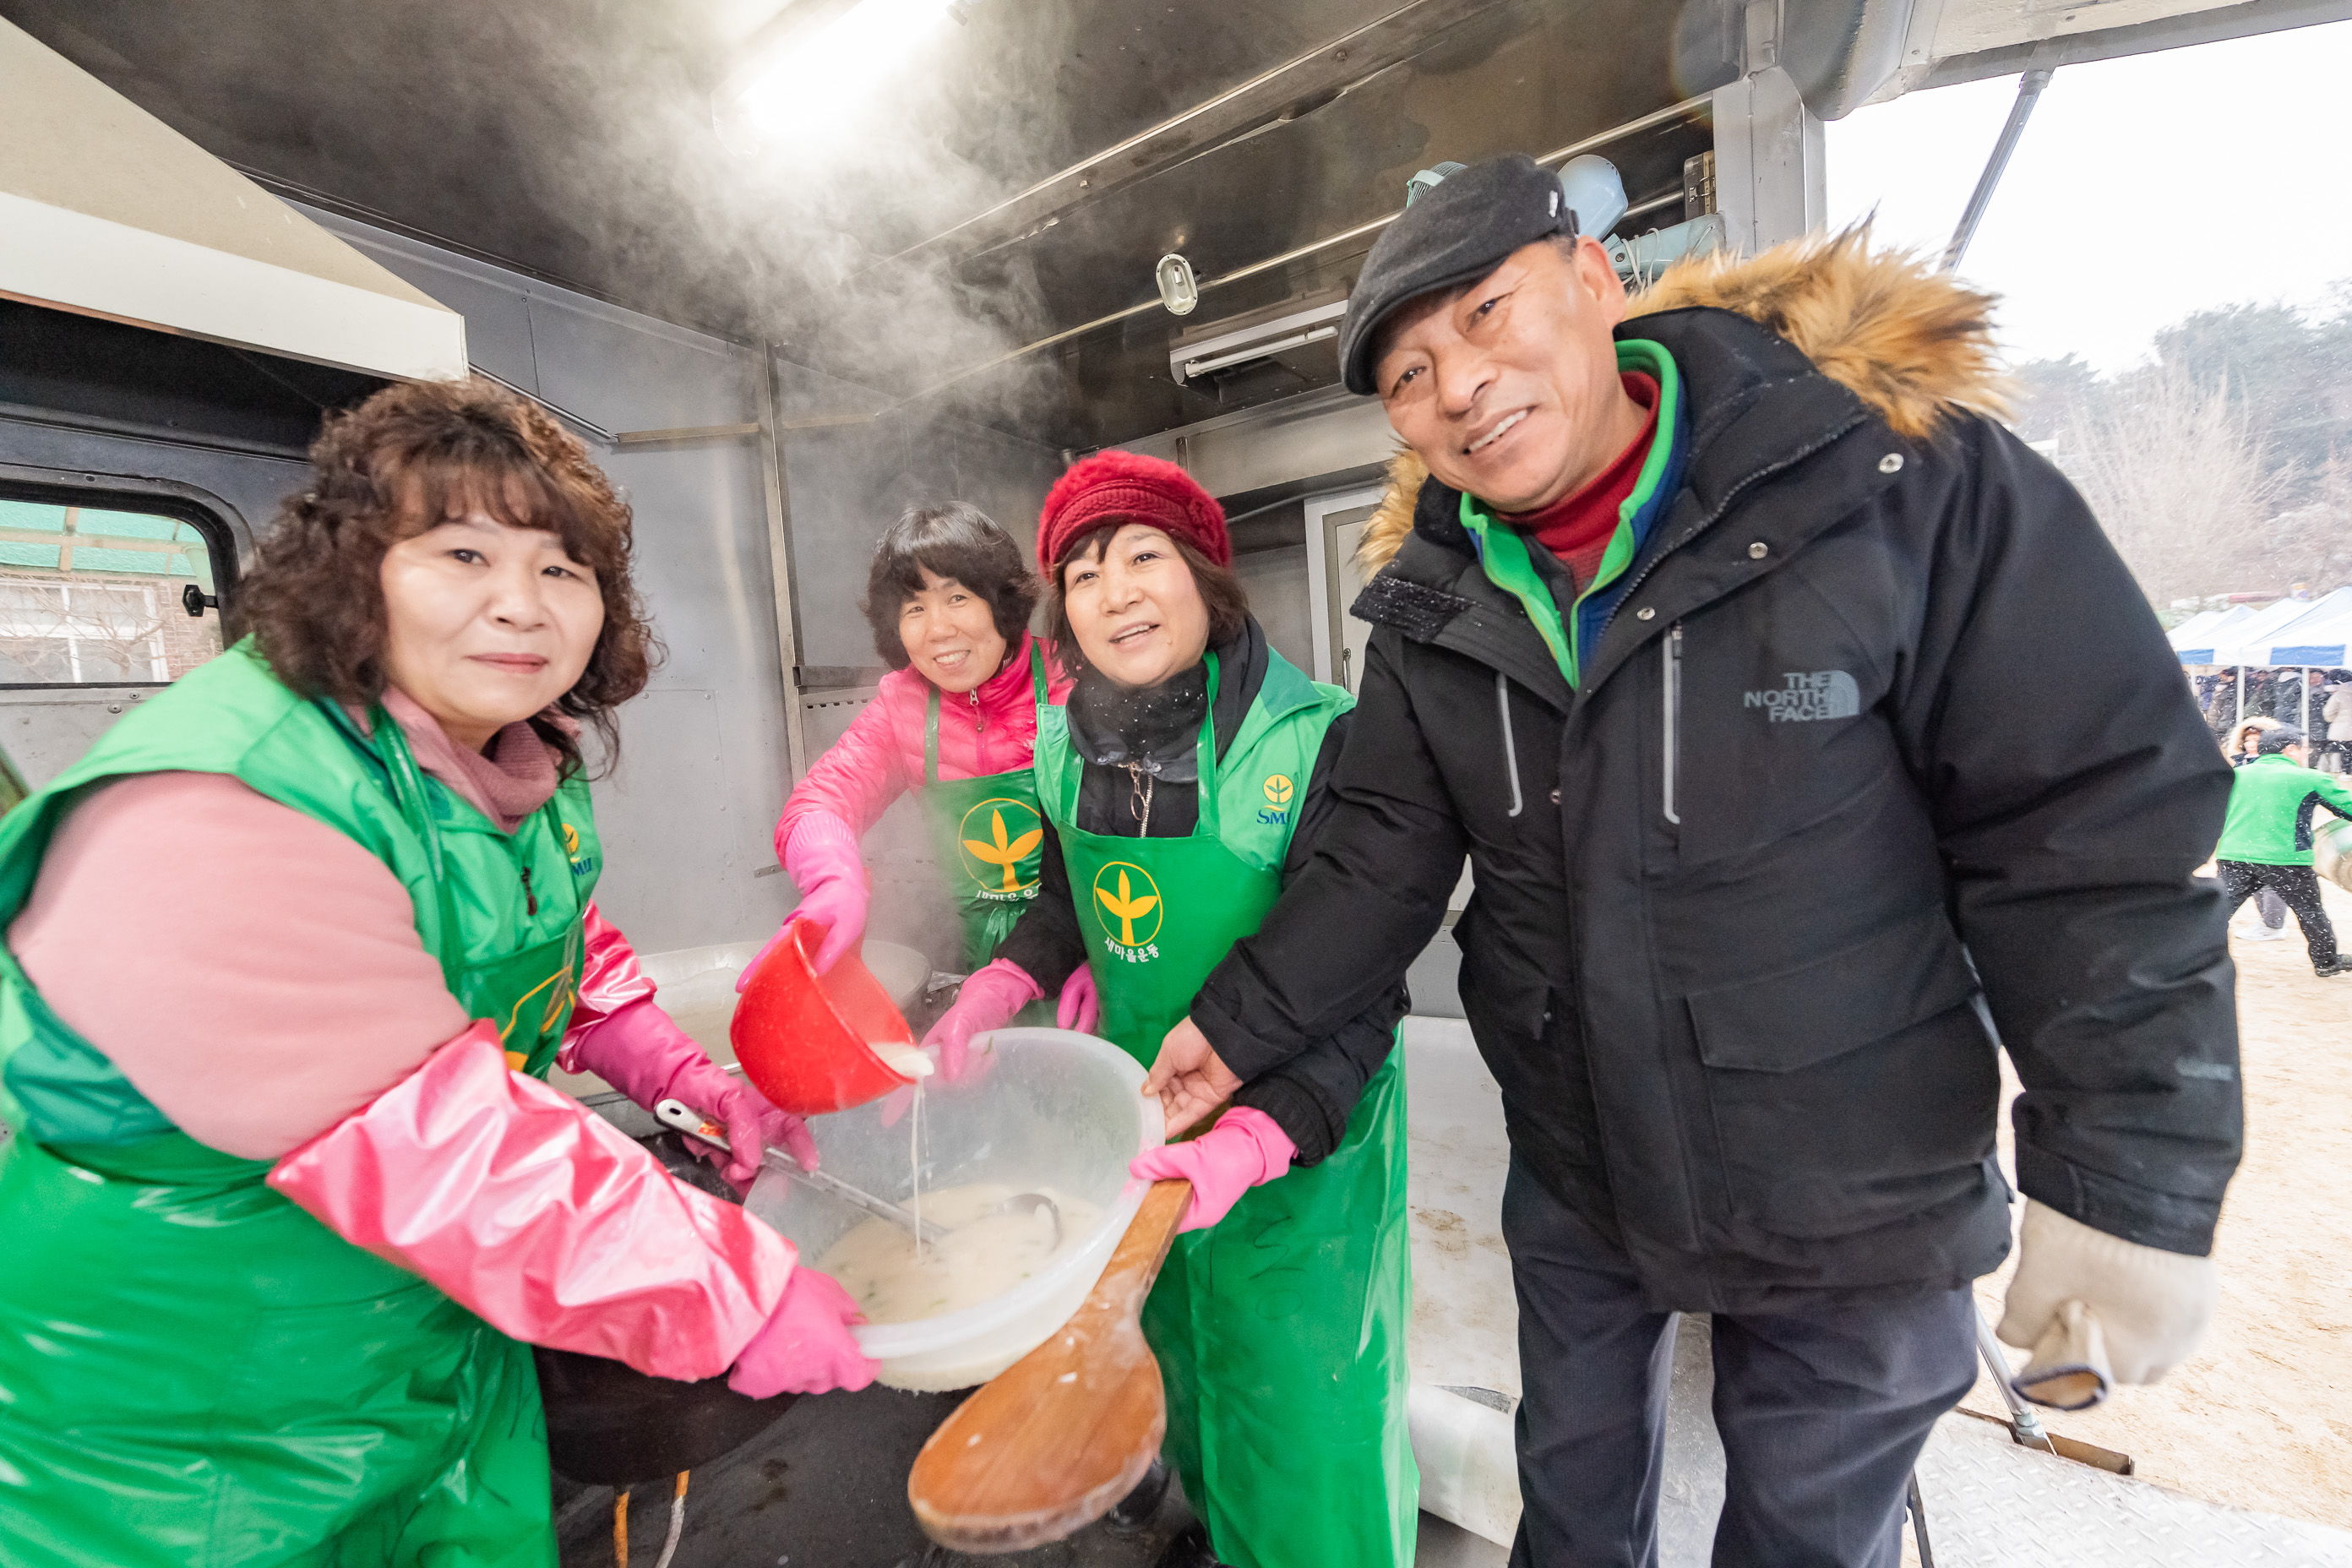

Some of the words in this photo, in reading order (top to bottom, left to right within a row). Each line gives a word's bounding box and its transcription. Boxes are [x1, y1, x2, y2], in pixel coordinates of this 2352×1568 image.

[1783, 670, 1831, 689] THE
[1744, 689, 1831, 708] NORTH
[1769, 704, 1831, 723] FACE
[1104, 936, 1159, 963] 새마을운동
